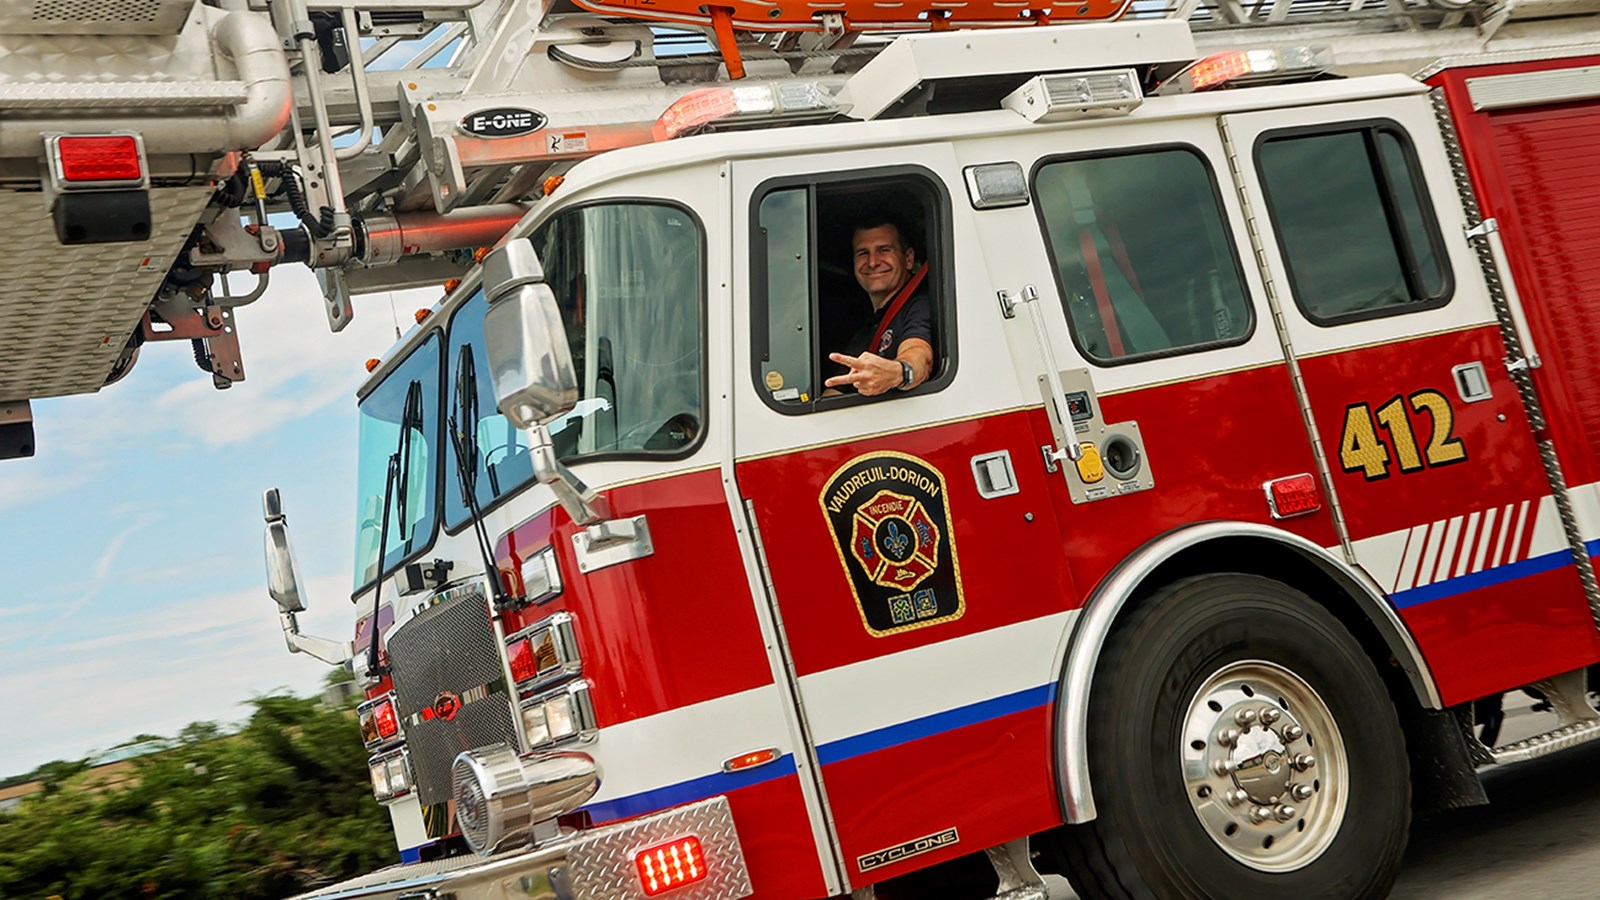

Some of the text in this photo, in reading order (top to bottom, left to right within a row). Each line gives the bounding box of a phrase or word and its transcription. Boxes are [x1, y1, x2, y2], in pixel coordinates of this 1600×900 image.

[473, 113, 532, 131] E-ONE
[1339, 389, 1467, 481] 412
[828, 466, 940, 513] VAUDREUIL-DORION
[869, 500, 904, 516] INCENDIE
[862, 831, 955, 868] CYCLONE
